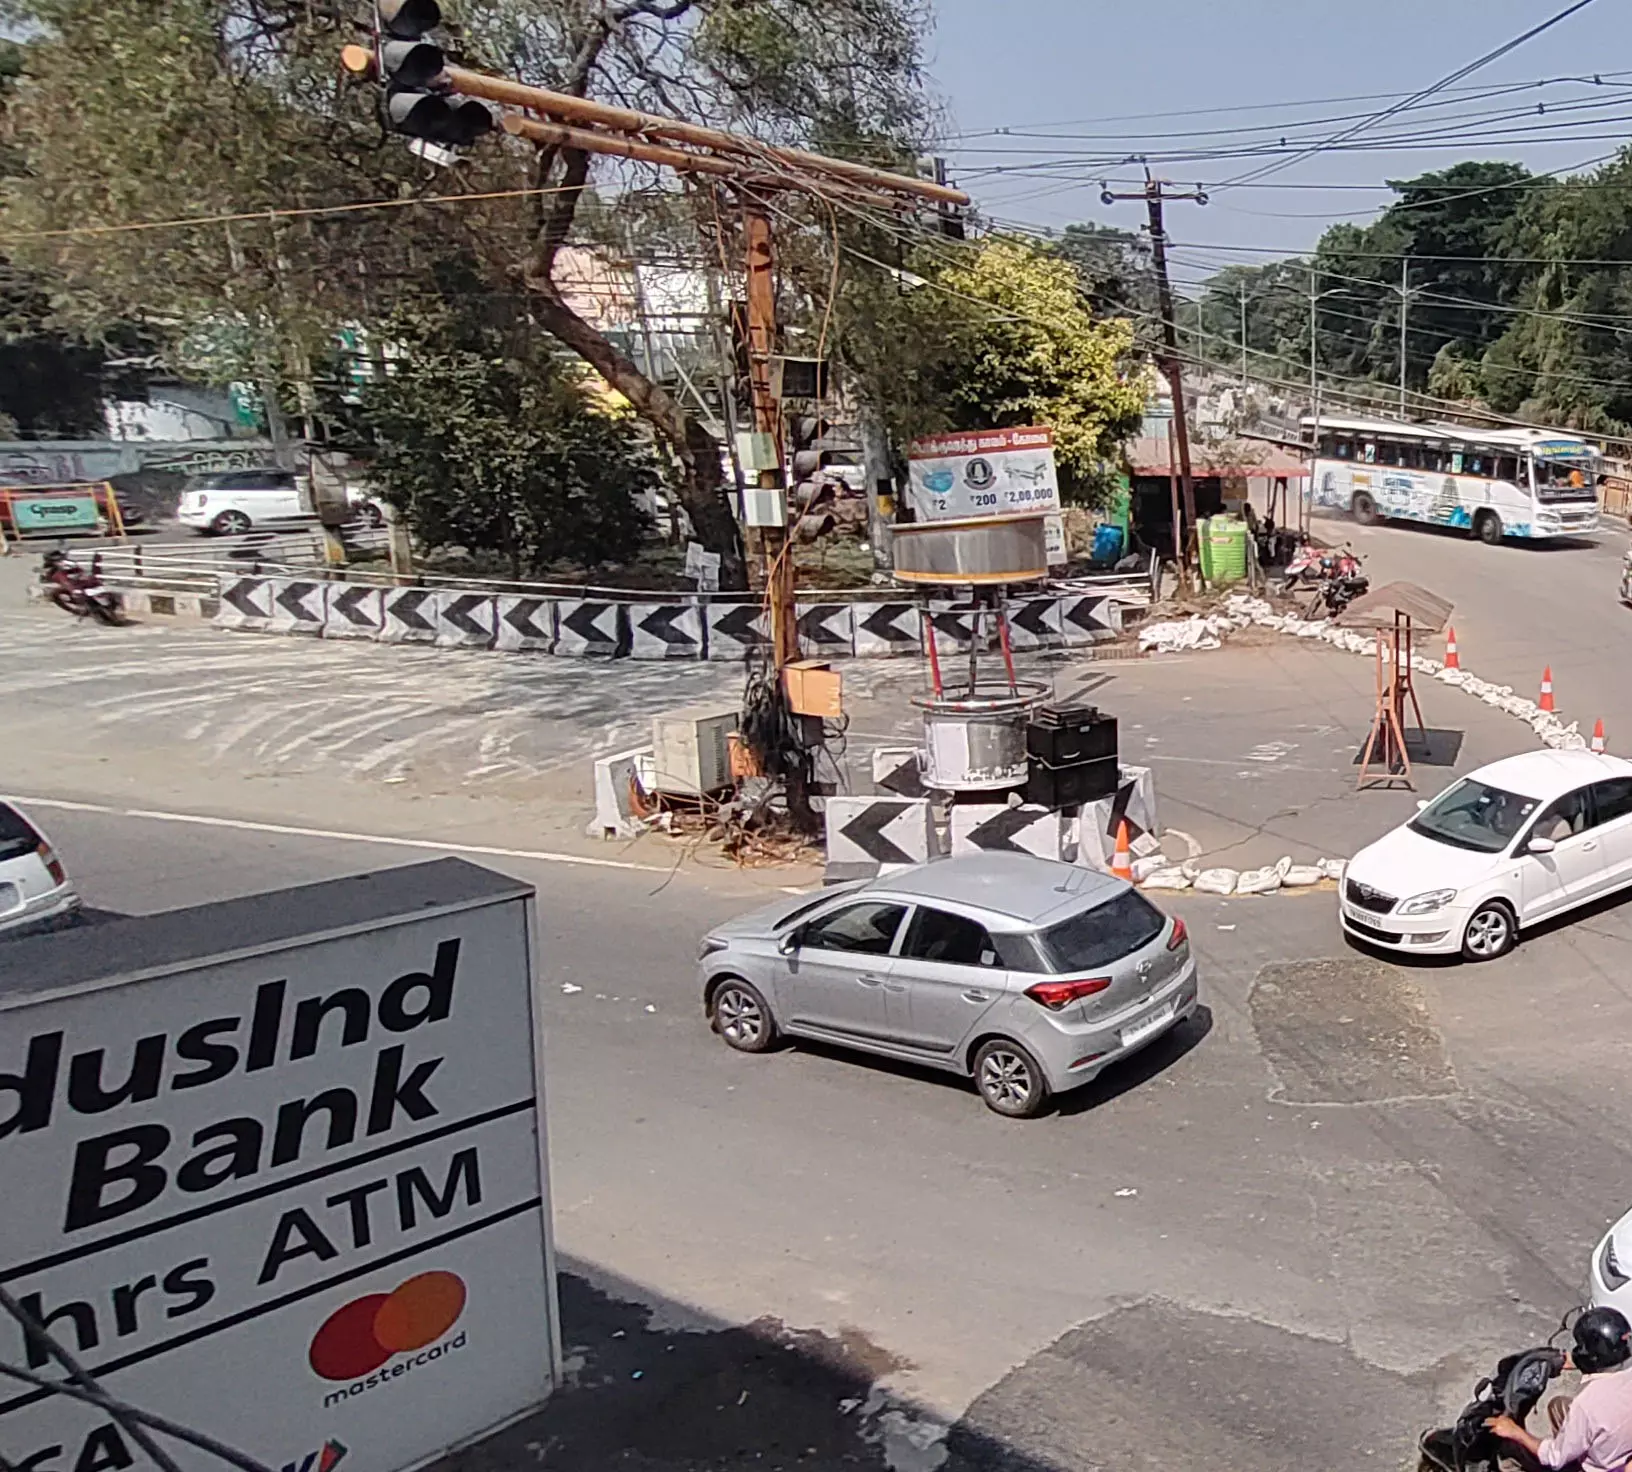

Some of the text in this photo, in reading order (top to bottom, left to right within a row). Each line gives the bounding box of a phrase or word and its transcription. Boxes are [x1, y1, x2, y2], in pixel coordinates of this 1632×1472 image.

[63, 1044, 445, 1234] Bank
[20, 1146, 483, 1370] hrs ATM
[323, 1331, 467, 1408] mastercard
